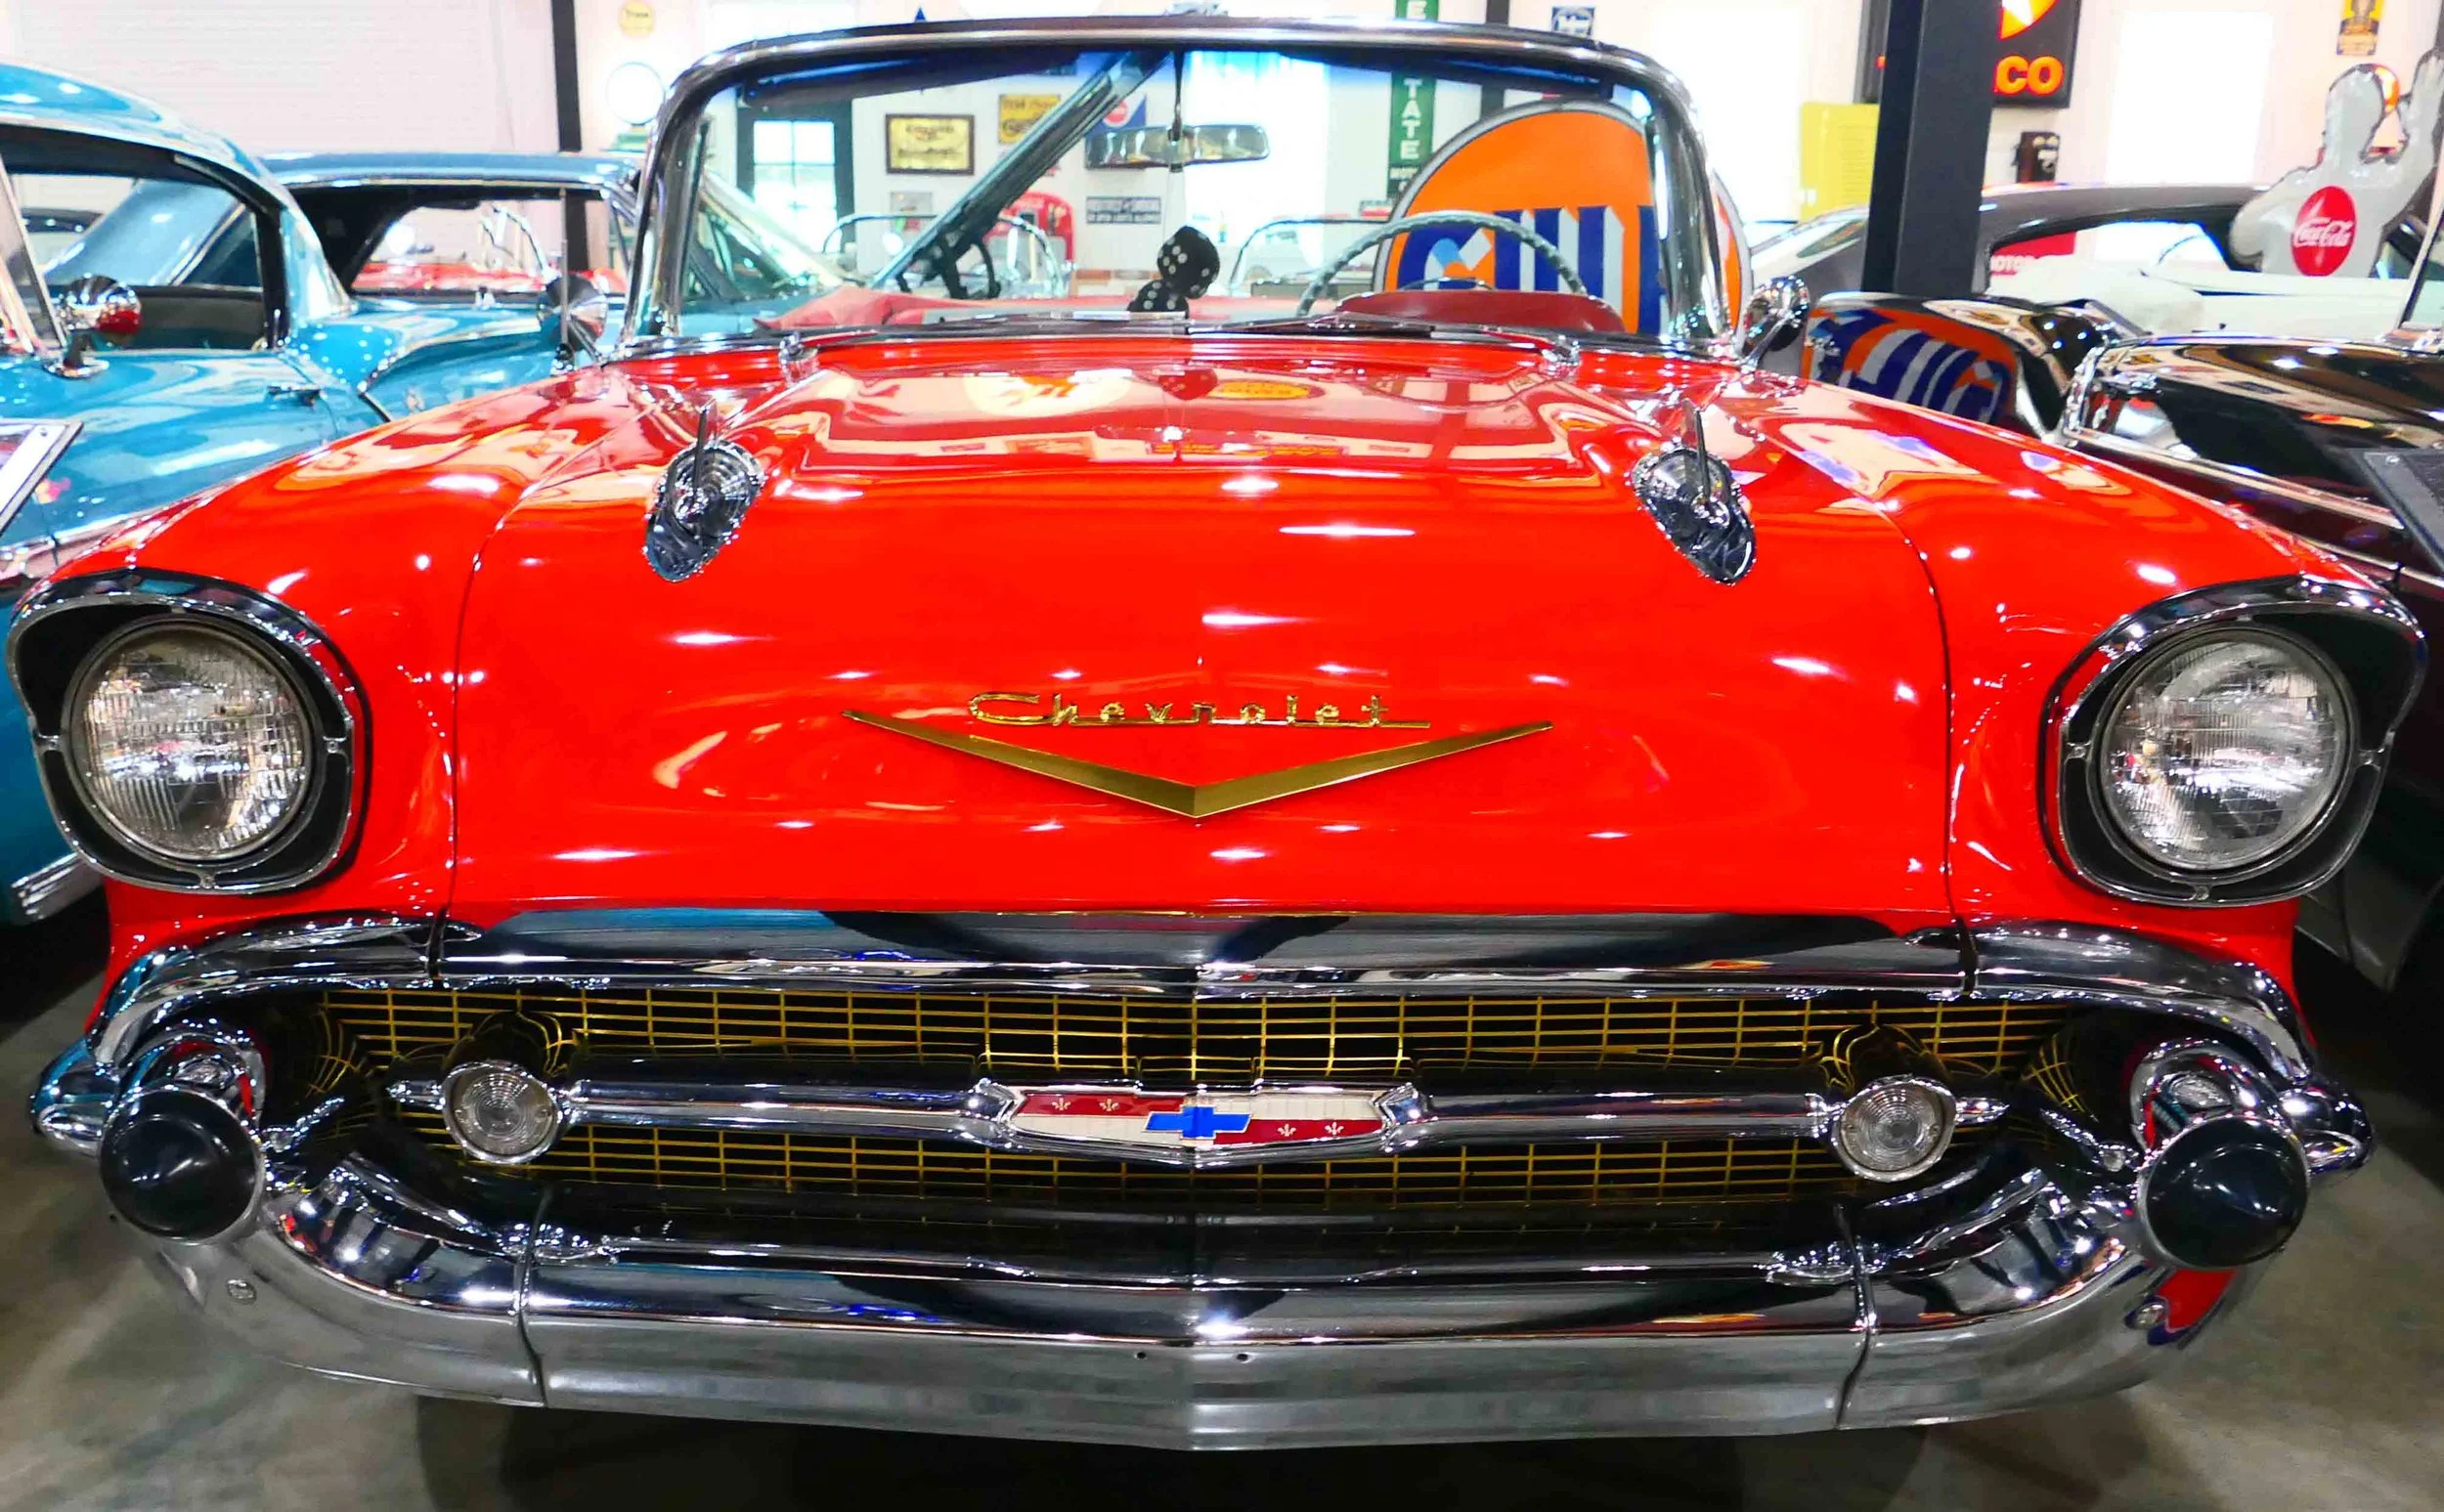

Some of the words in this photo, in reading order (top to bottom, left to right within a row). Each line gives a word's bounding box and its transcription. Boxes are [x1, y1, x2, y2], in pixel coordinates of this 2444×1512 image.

[1994, 55, 2066, 95] CO
[1400, 78, 1423, 160] TATE
[968, 692, 1431, 729] Chevrolet
